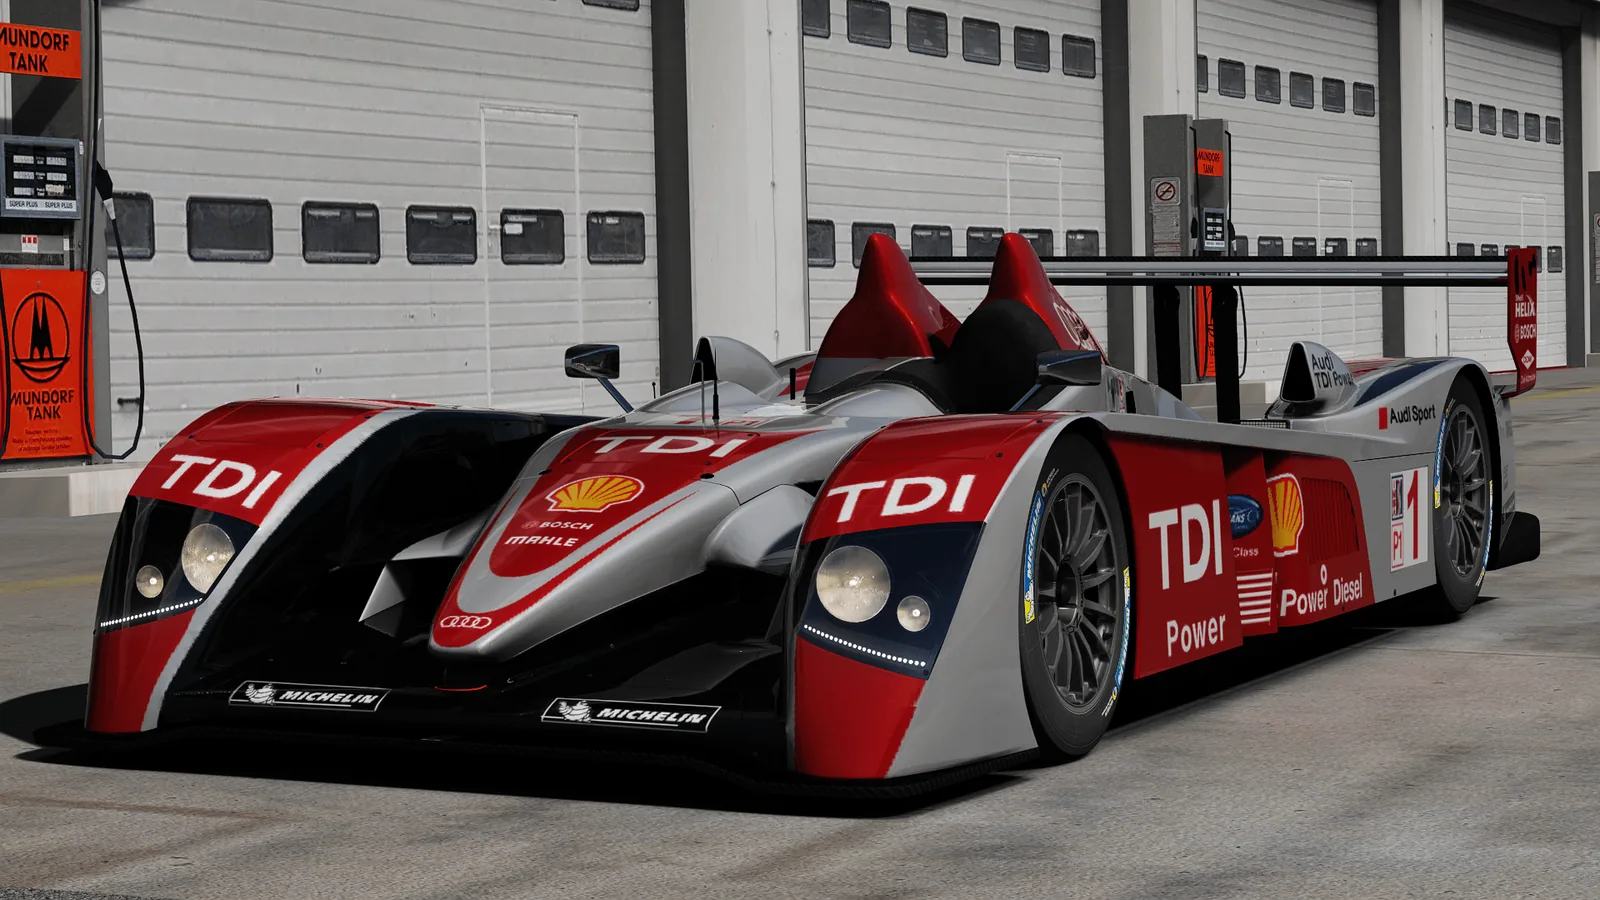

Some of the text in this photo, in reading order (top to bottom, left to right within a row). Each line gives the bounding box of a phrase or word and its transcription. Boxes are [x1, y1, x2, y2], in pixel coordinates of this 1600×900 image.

[0, 26, 70, 52] MUNDORF
[9, 52, 48, 72] TANK
[1197, 151, 1220, 162] MUNDORF
[1203, 164, 1214, 174] TANK
[1515, 302, 1536, 317] HELIX
[1520, 324, 1536, 339] BOSCH
[1312, 351, 1334, 370] Audi
[1315, 373, 1332, 388] TDI
[10, 389, 75, 405] MUNDORF
[27, 406, 61, 420] TANK
[1390, 405, 1436, 425] Audi Sport
[594, 435, 748, 458] TDI
[160, 454, 283, 509] TDI
[827, 474, 976, 523] TDI
[1407, 470, 1418, 559] 1
[540, 521, 594, 530] BOSCH
[504, 536, 579, 547] MAHLE
[1149, 499, 1223, 590] TDI
[1393, 531, 1402, 560] P1
[1233, 547, 1258, 557] Class
[1280, 572, 1363, 617] Power Diesel
[1166, 614, 1226, 657] Power
[279, 690, 379, 704] MICHELIN
[597, 708, 707, 724] MICHELIN
